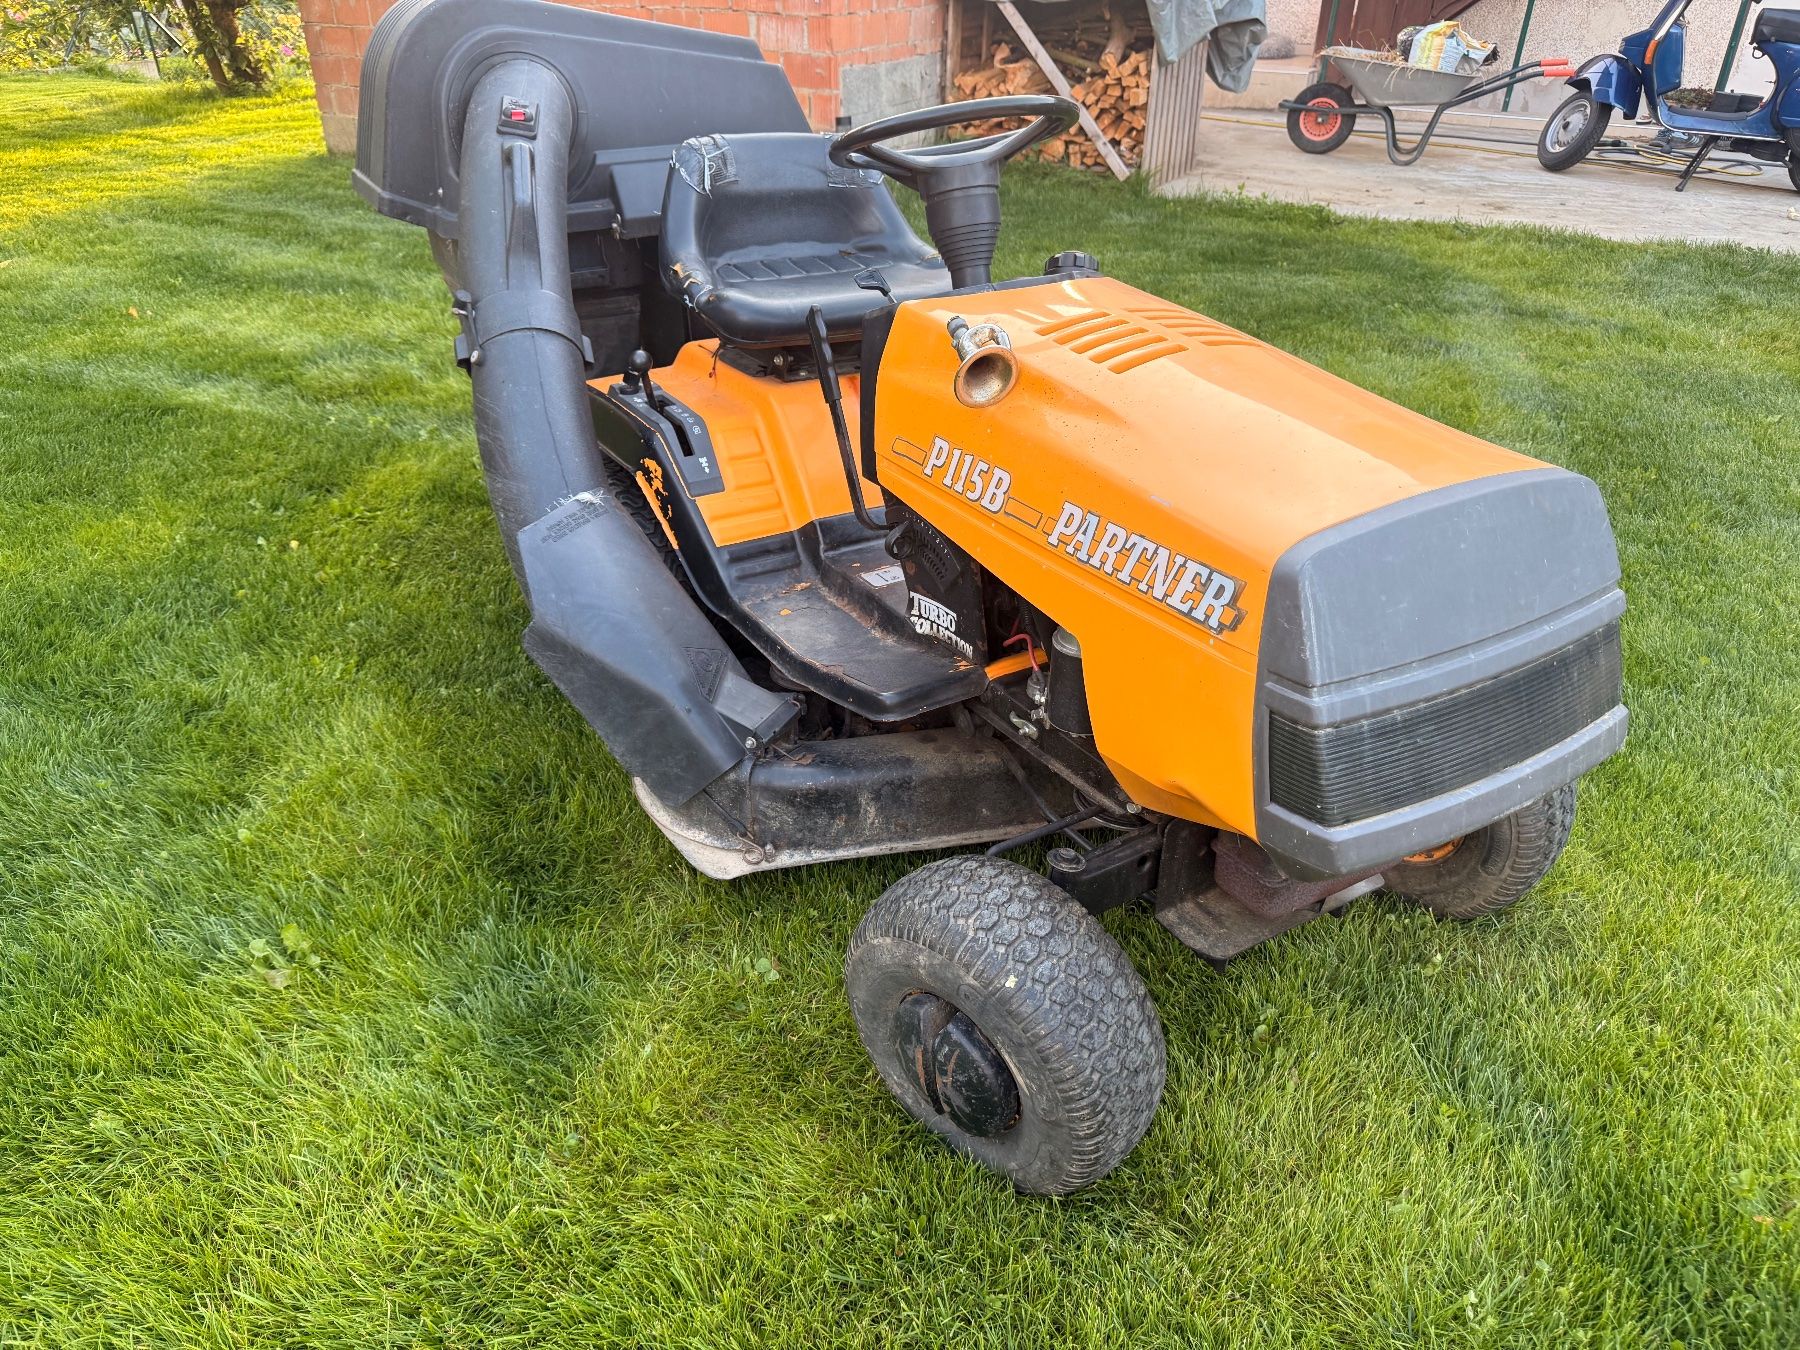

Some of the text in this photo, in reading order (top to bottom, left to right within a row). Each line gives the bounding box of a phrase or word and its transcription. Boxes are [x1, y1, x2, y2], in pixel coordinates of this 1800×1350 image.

[923, 435, 1012, 514] P115B
[1047, 500, 1237, 632] PARTNER
[909, 590, 957, 633] TURBO
